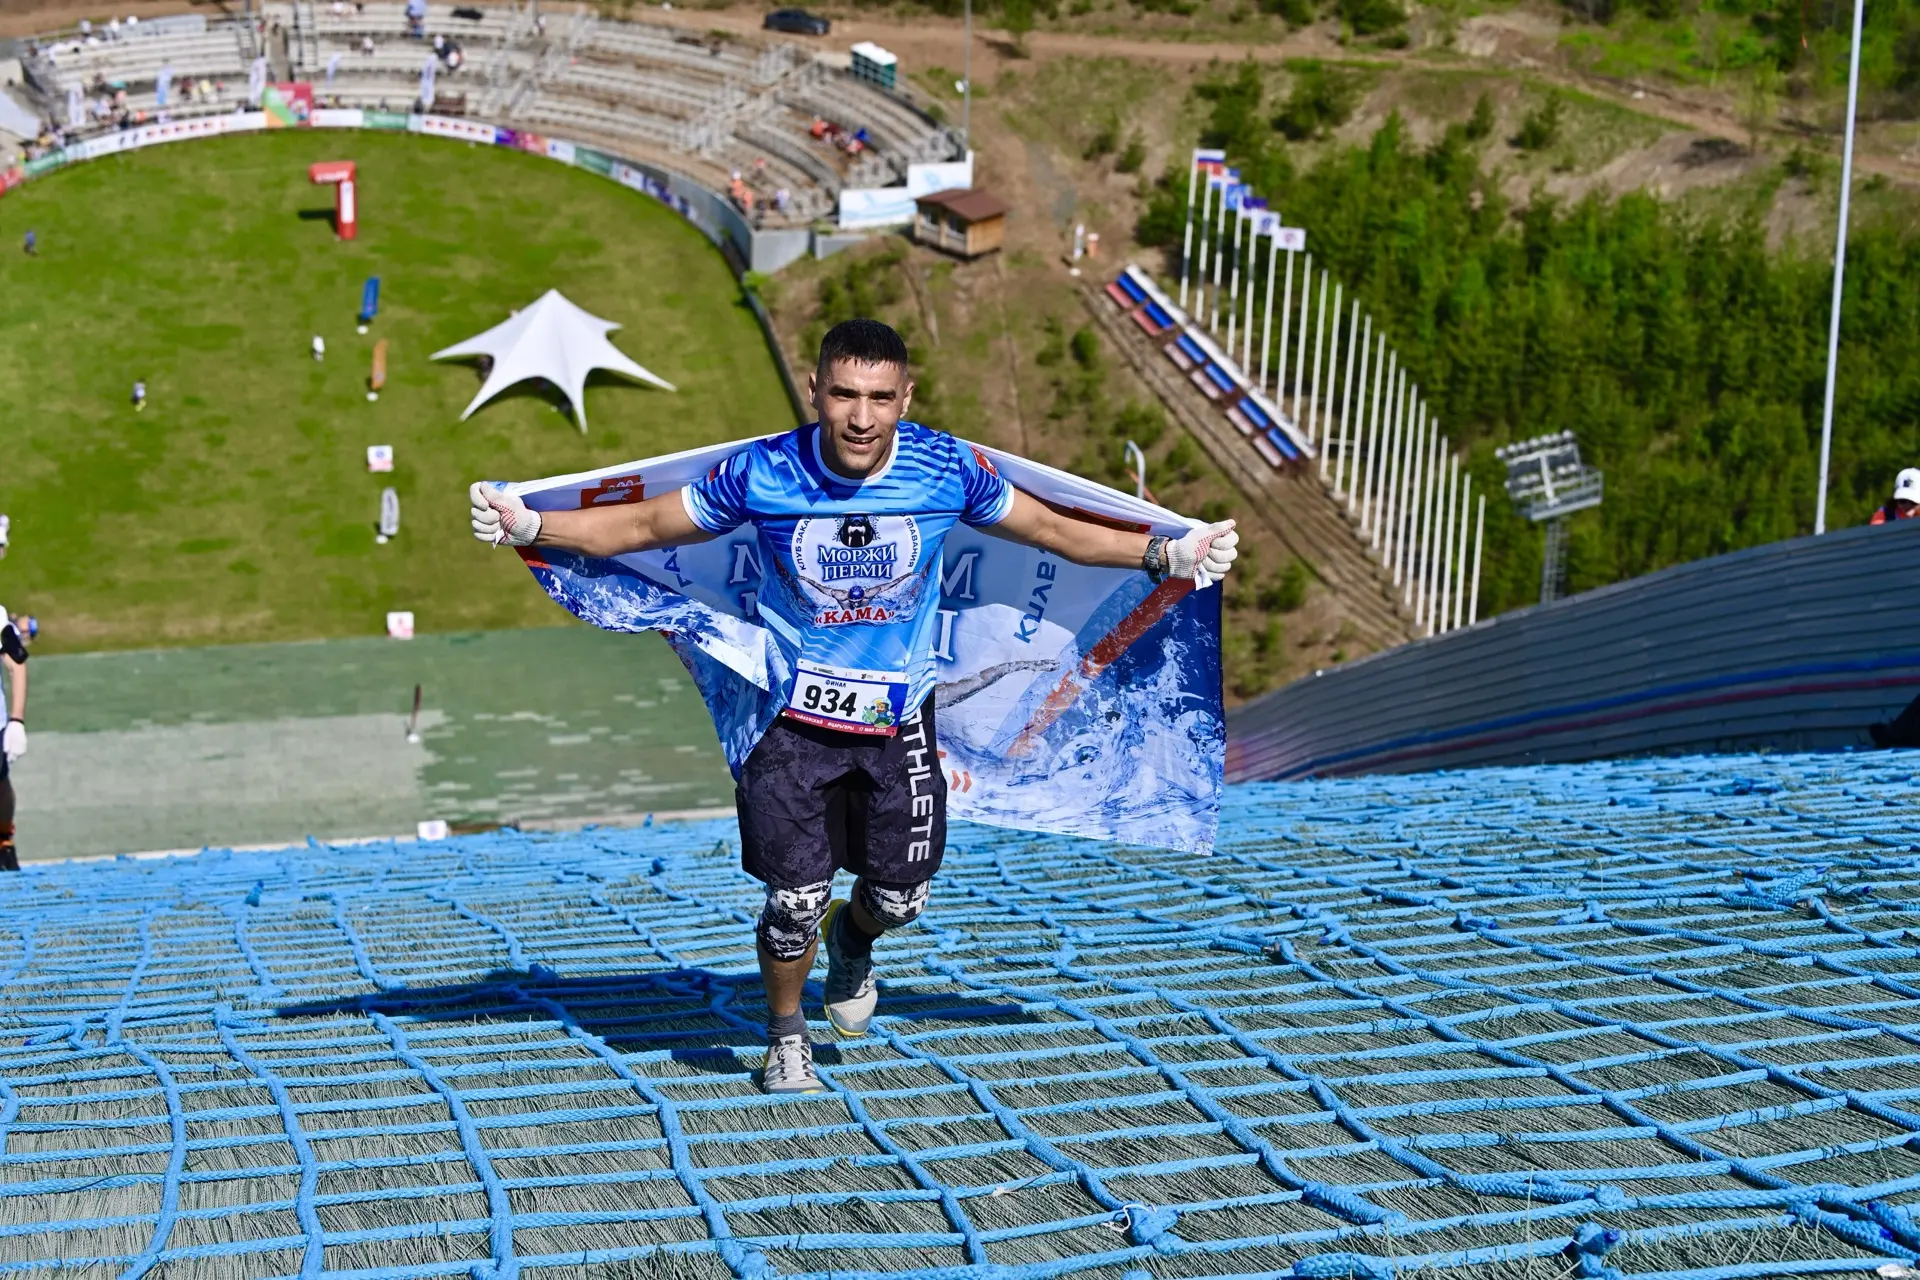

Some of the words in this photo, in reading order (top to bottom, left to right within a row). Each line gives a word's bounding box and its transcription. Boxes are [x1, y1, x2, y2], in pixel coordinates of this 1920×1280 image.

[818, 543, 897, 564] МОРЖИ
[904, 517, 919, 568] ПЛАВАНИЯ
[795, 545, 807, 571] КЛУБ
[823, 563, 892, 581] ПЕРМИ
[803, 684, 857, 717] 934
